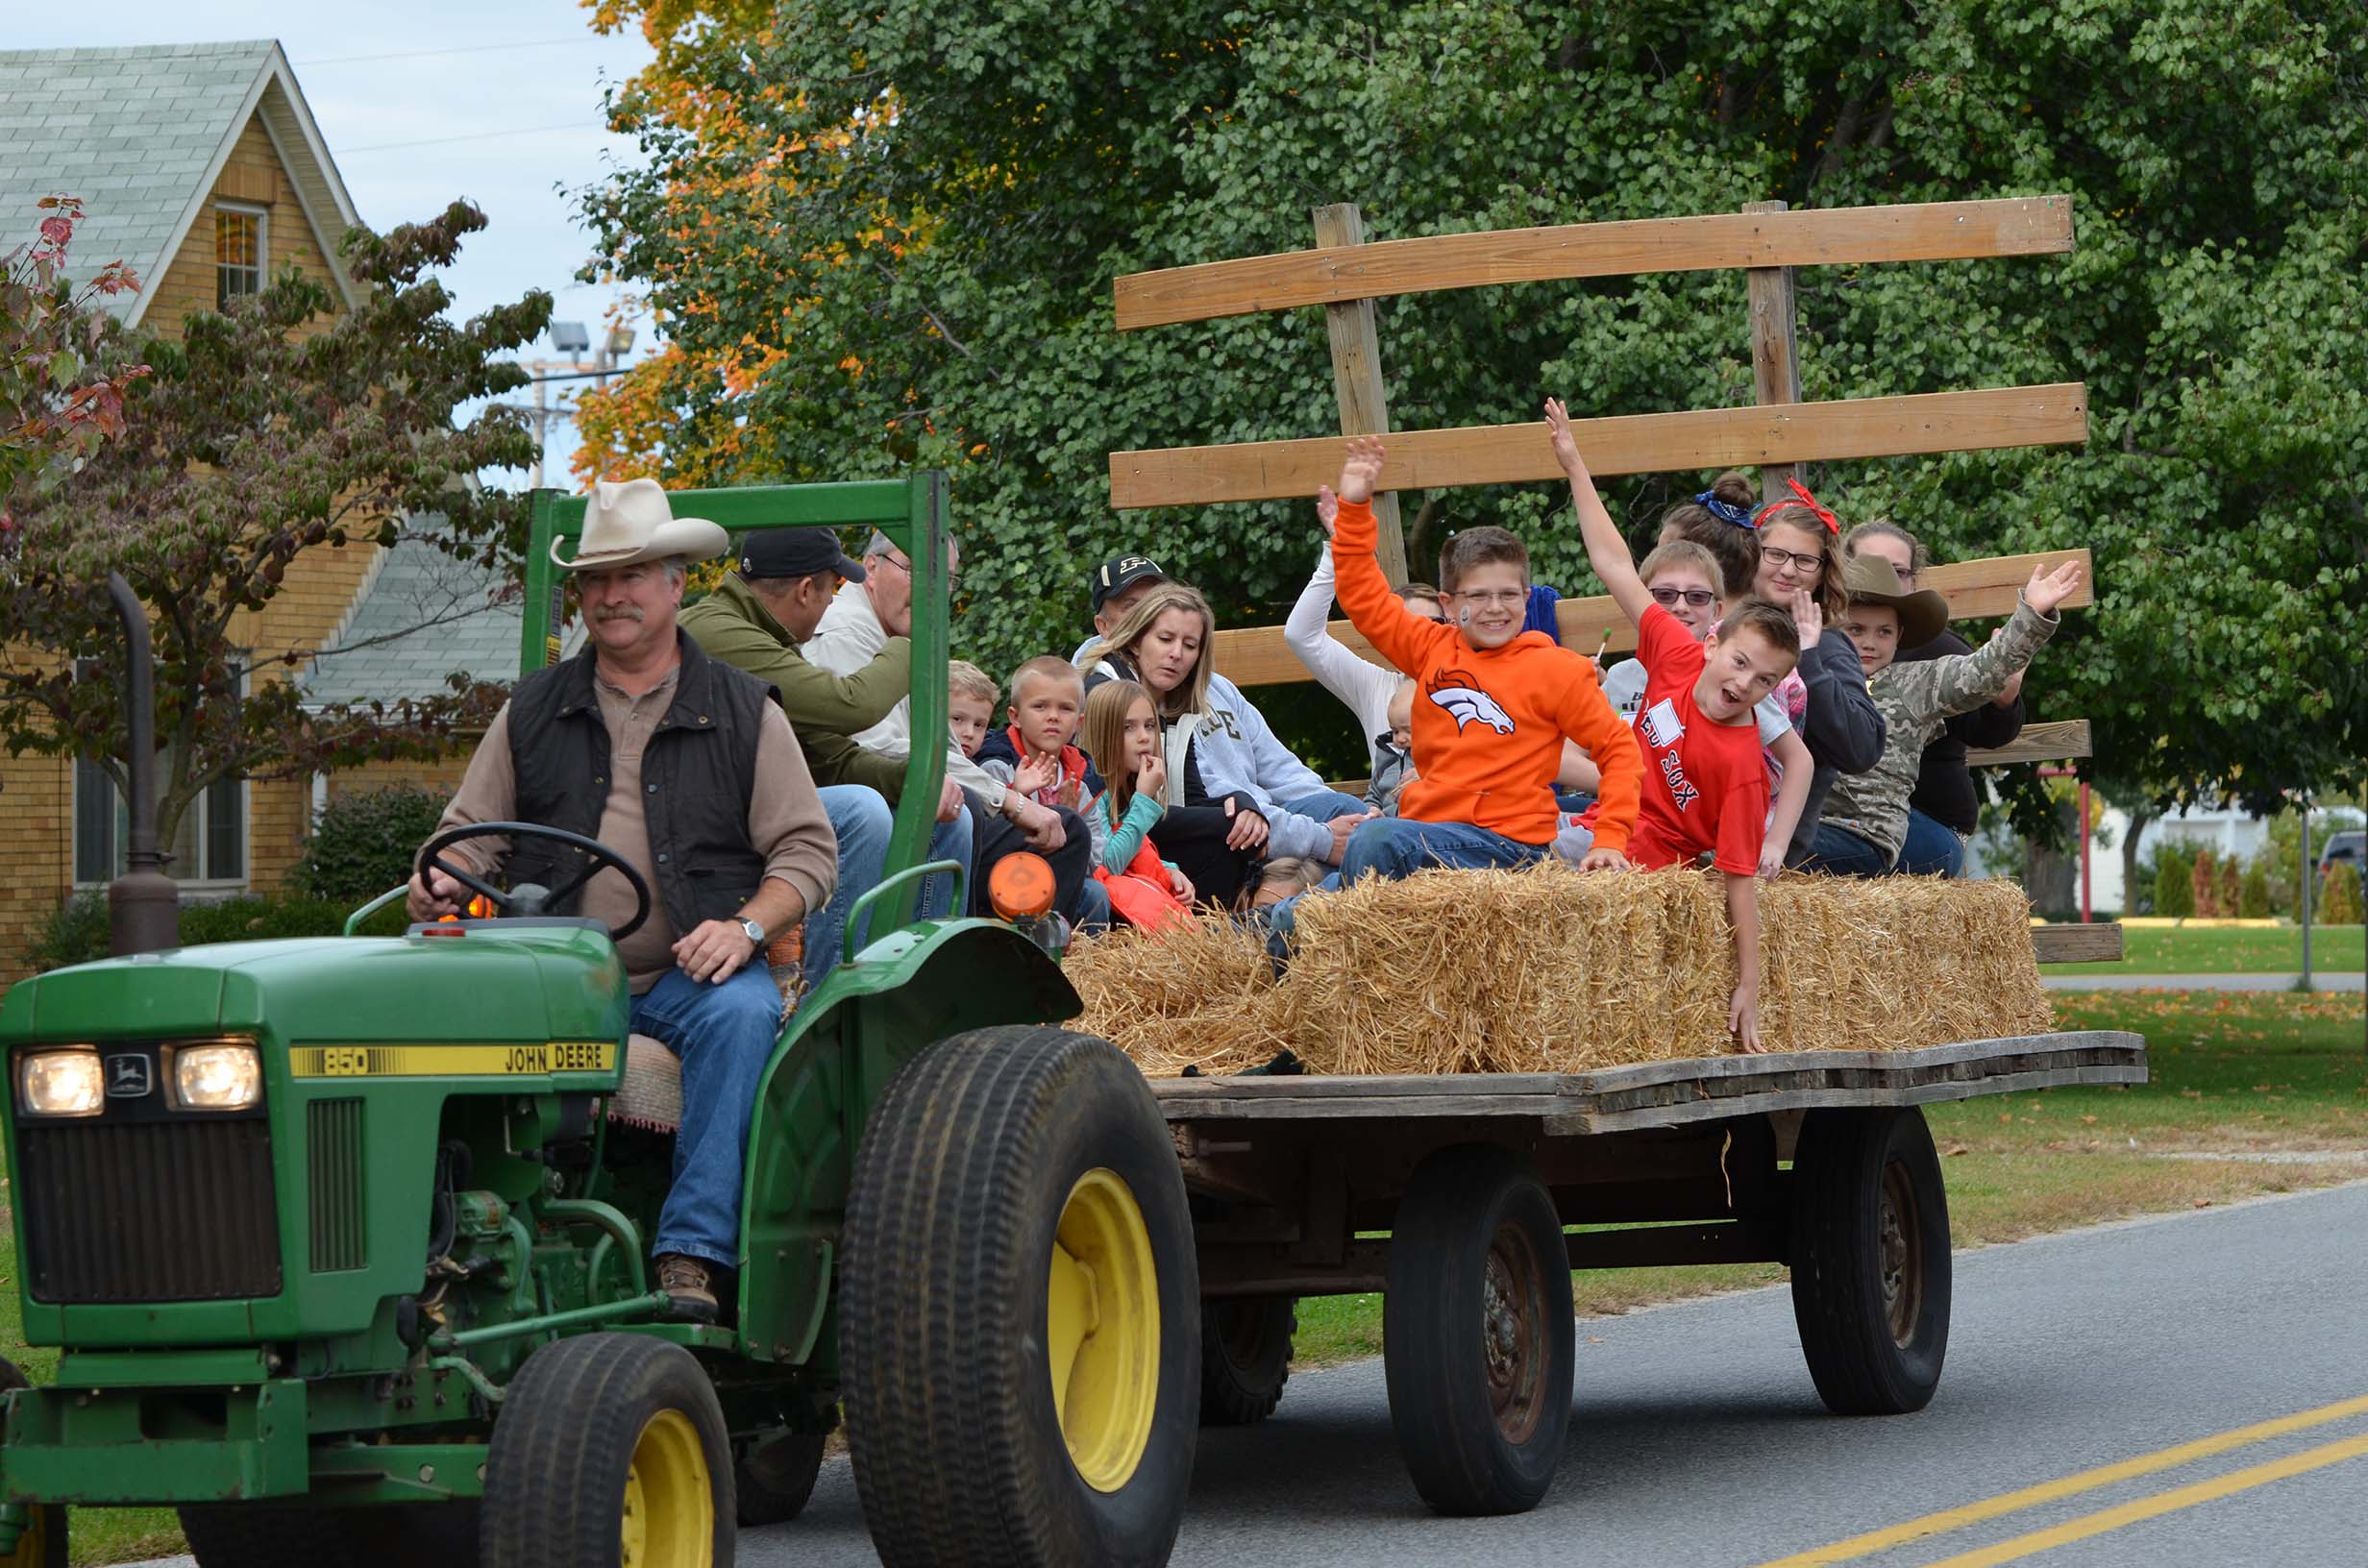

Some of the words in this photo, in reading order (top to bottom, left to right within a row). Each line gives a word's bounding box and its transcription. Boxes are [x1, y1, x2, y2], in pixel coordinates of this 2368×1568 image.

[1661, 749, 1700, 813] SOX
[324, 1047, 368, 1075] 850
[505, 1047, 547, 1072] JOHN
[555, 1044, 603, 1069] DEERE
